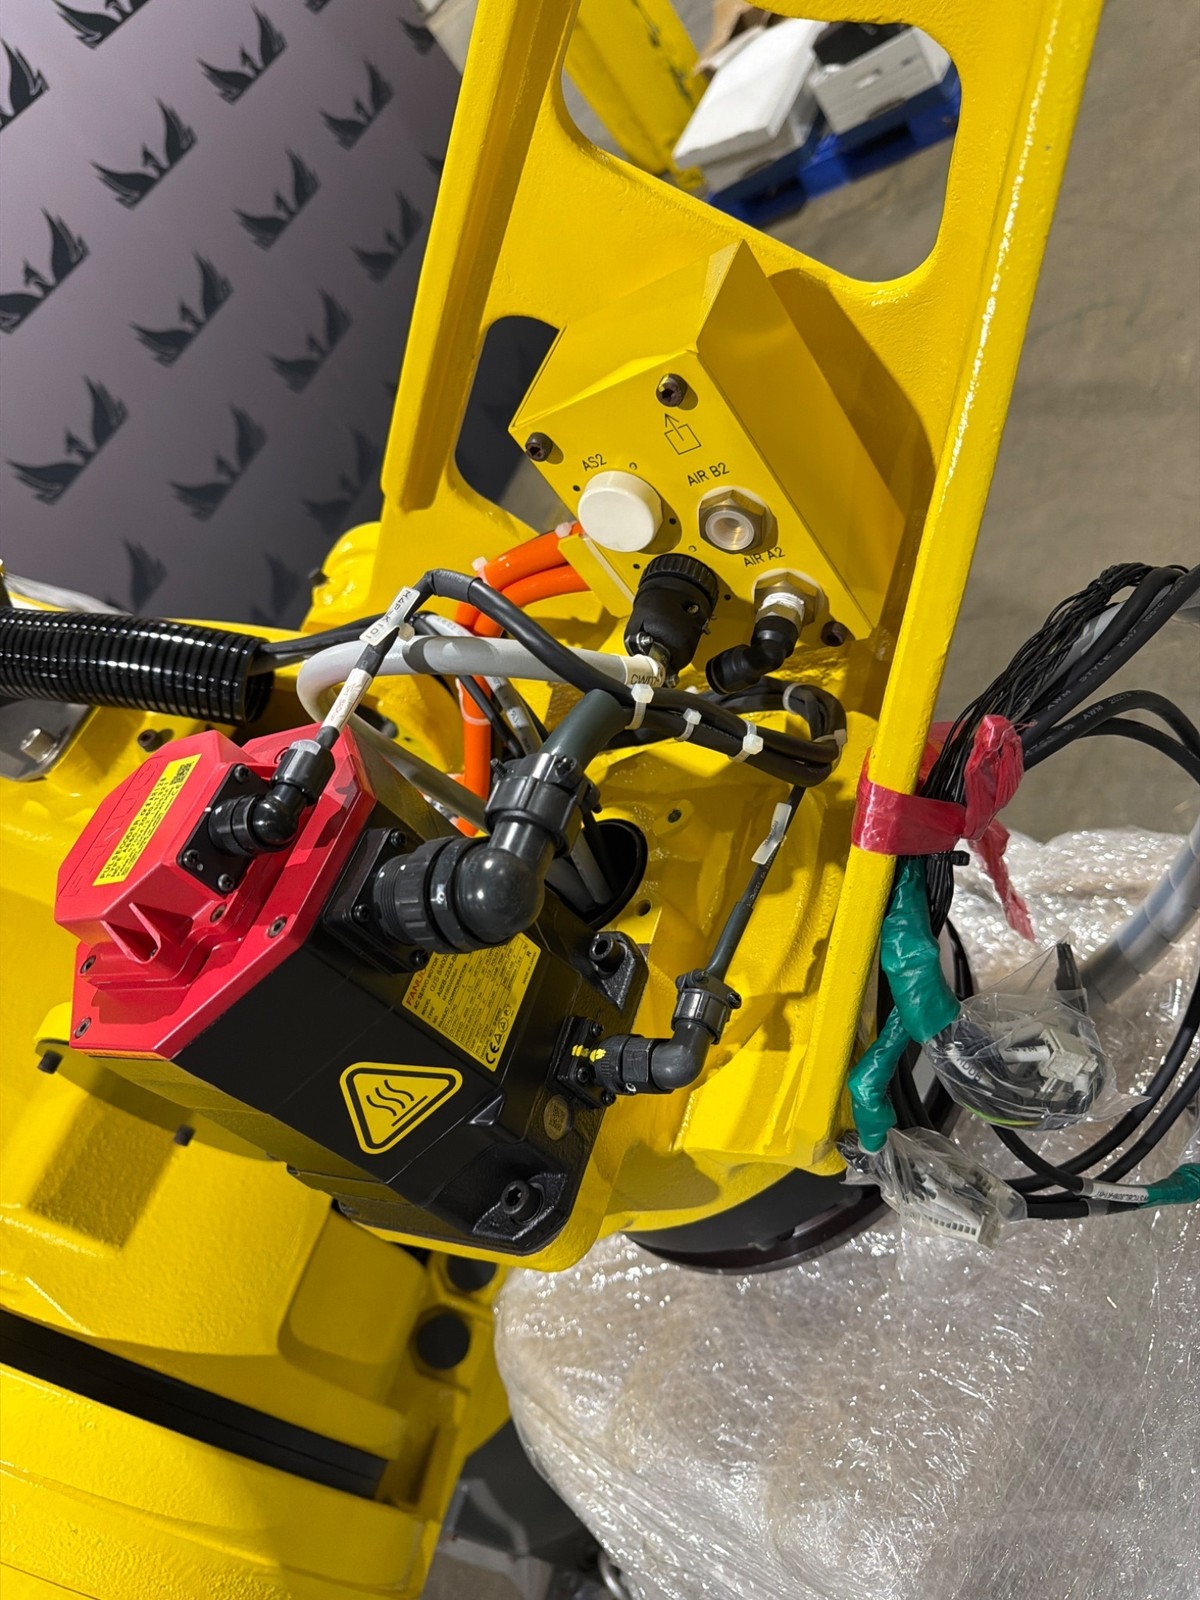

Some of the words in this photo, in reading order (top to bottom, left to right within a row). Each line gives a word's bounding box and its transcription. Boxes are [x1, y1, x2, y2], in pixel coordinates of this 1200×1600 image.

[582, 453, 607, 471] AS2
[687, 469, 707, 486] AIR
[709, 462, 730, 479] B2
[743, 552, 765, 568] AIR
[767, 546, 786, 561] A2
[412, 999, 420, 1009] AC
[417, 978, 430, 1000] SERVO
[427, 956, 439, 979] MOTOR
